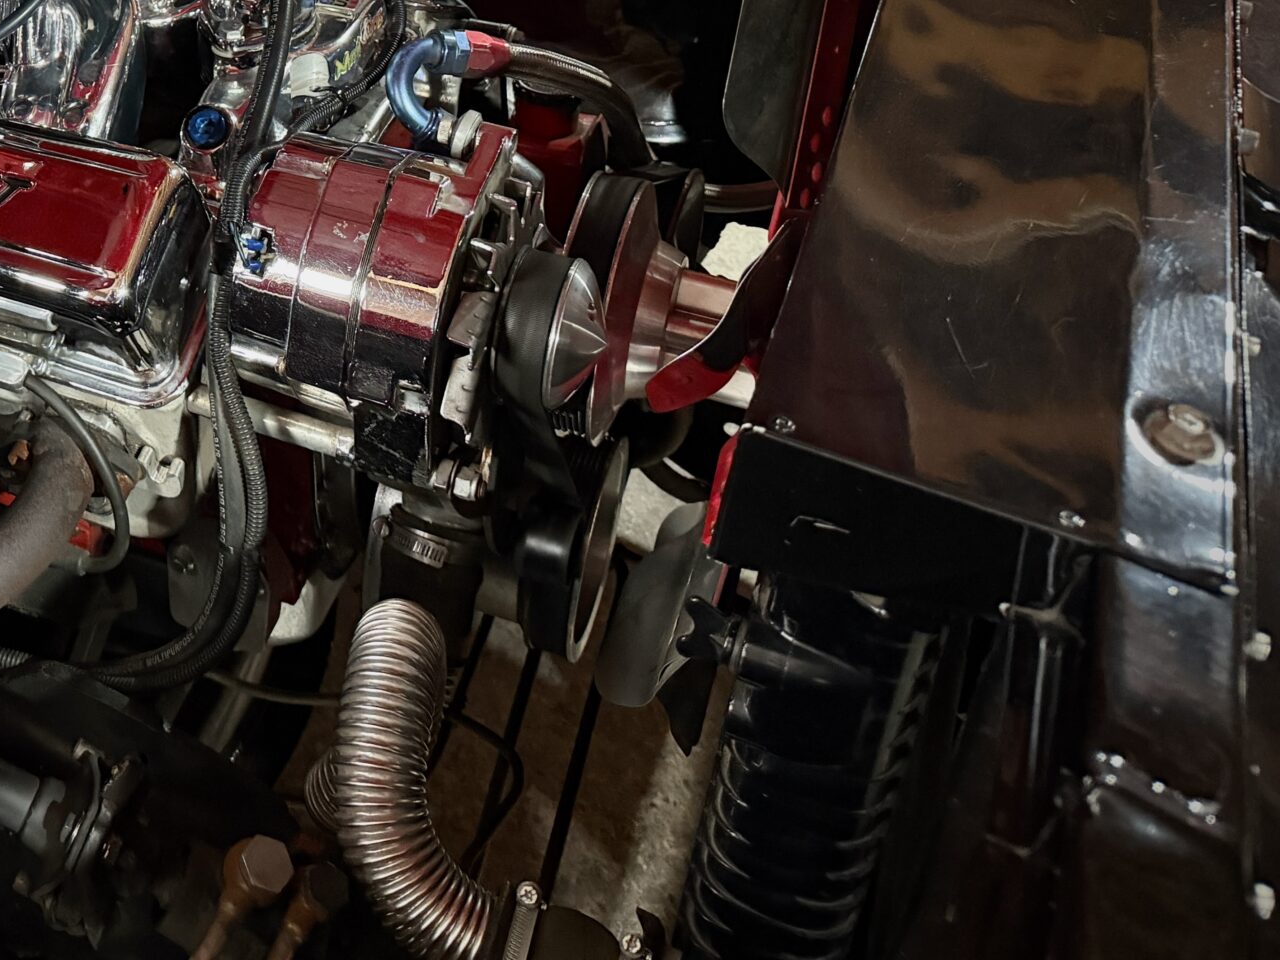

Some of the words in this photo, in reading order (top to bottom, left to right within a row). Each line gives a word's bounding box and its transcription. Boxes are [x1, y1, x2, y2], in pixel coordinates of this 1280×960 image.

[216, 462, 223, 479] WP
[218, 483, 226, 507] BAR
[219, 507, 226, 520] 20
[145, 631, 195, 669] MULTIPURPOSE
